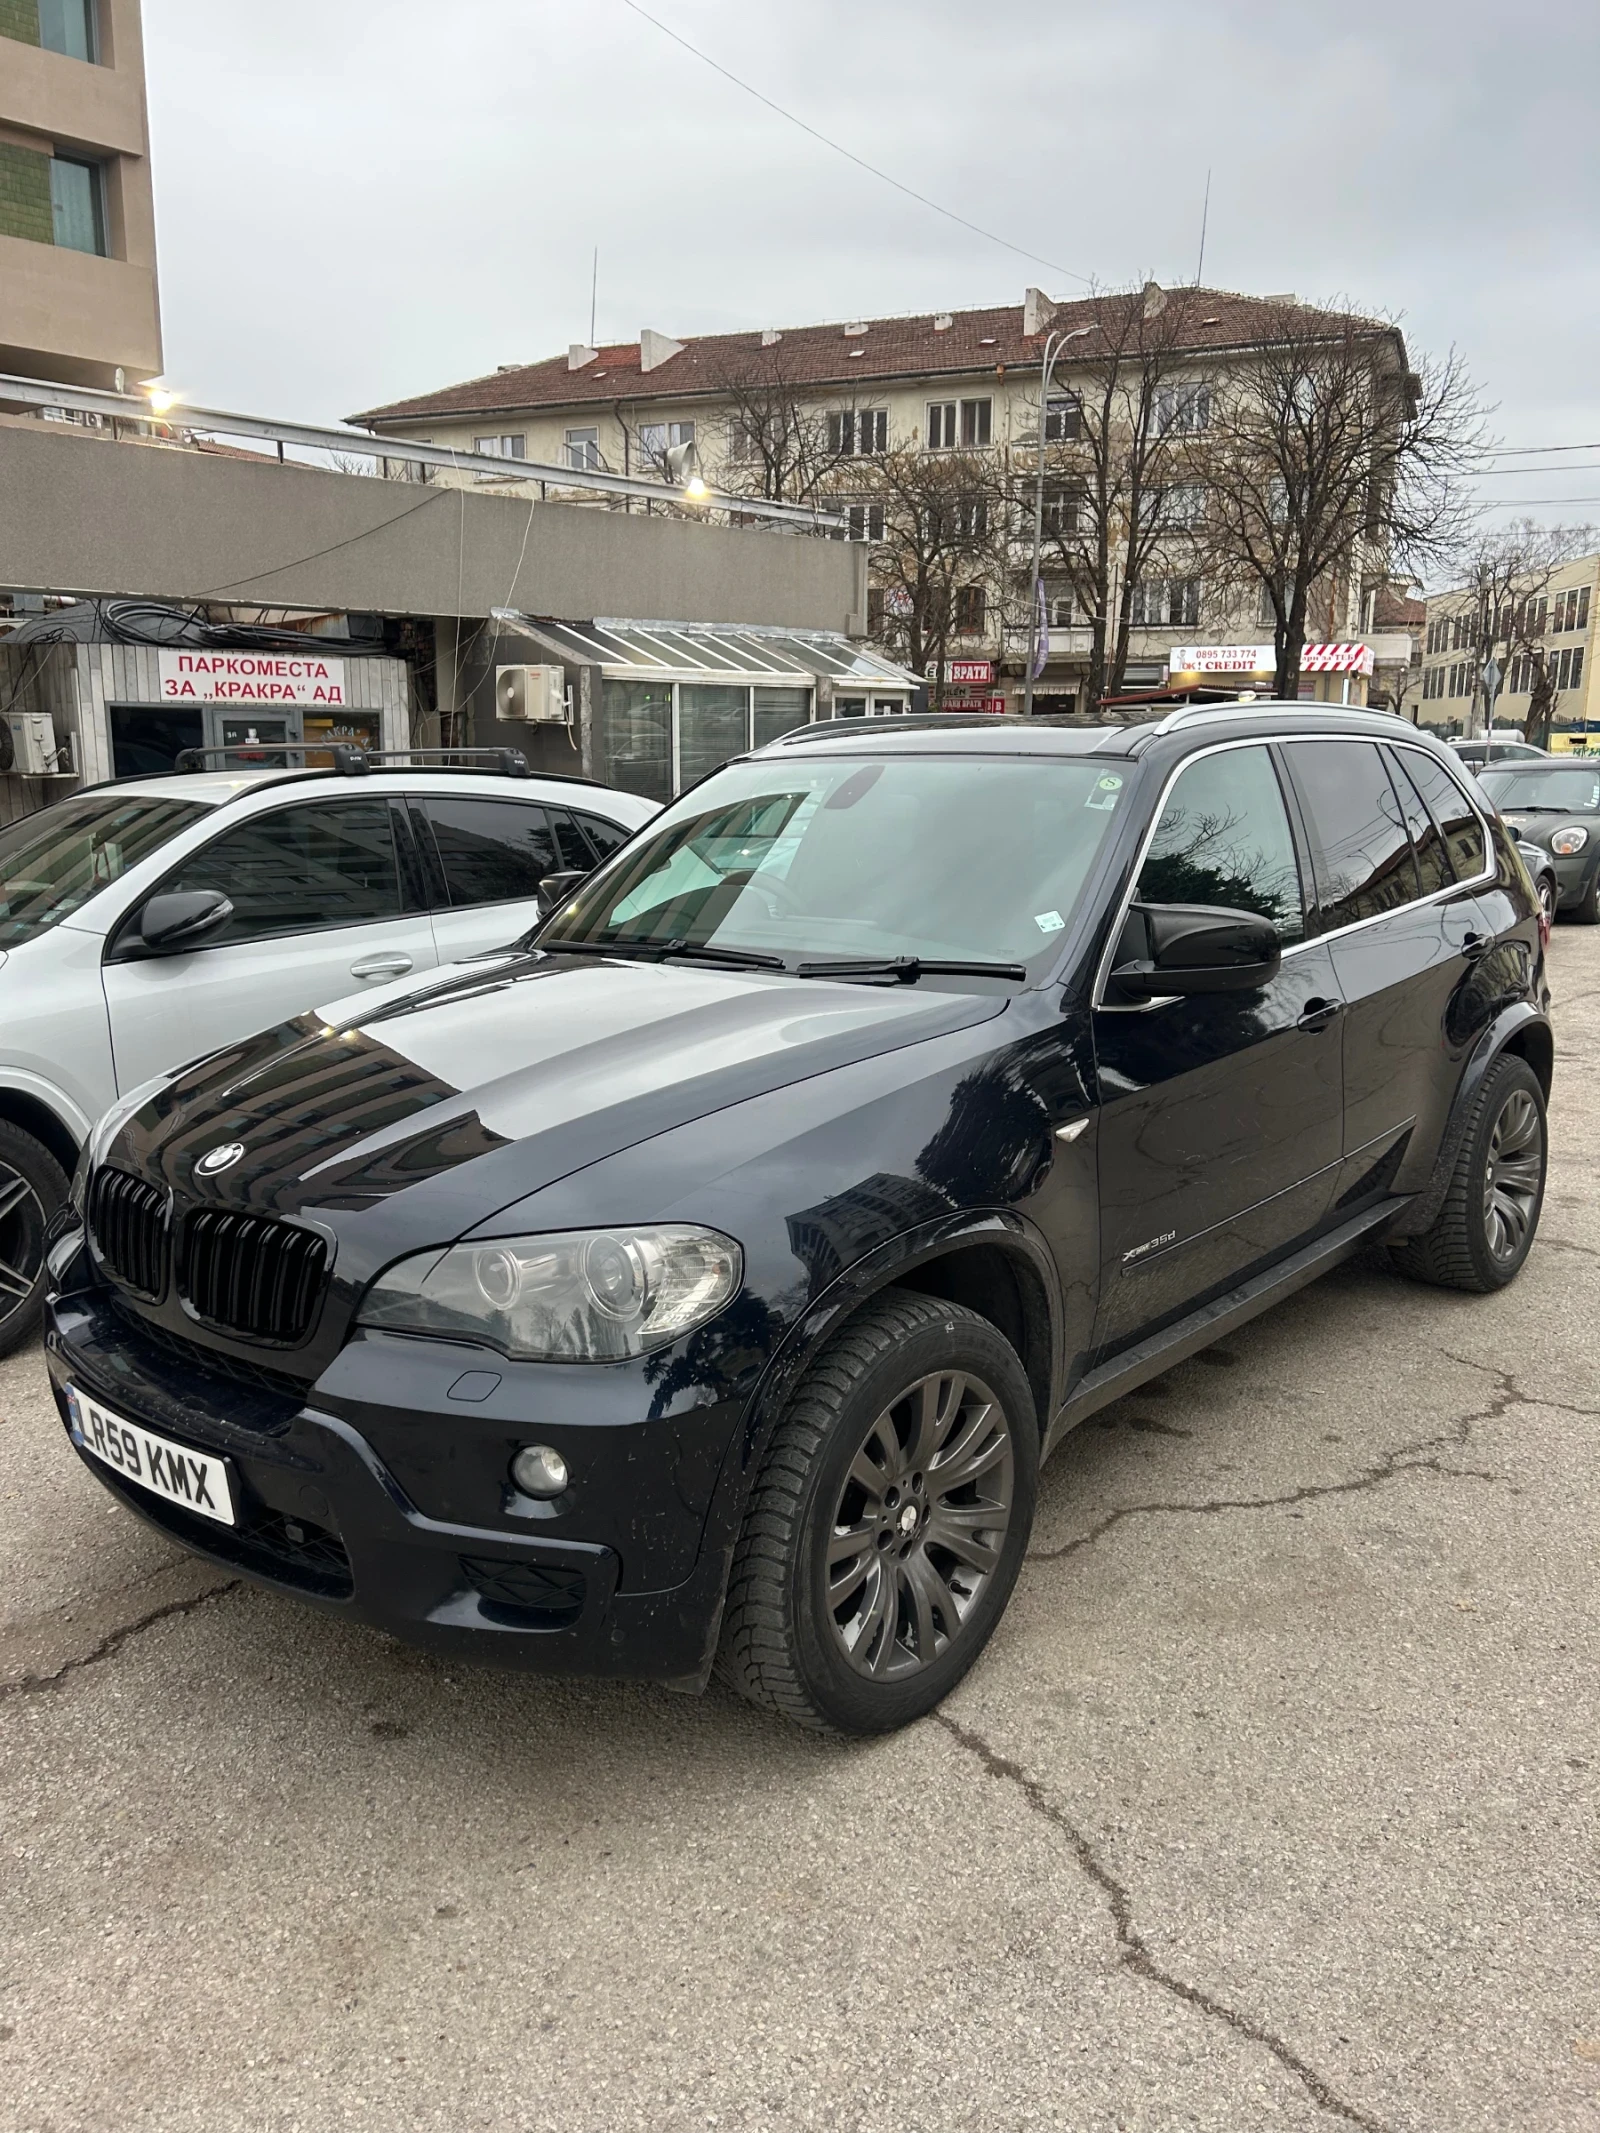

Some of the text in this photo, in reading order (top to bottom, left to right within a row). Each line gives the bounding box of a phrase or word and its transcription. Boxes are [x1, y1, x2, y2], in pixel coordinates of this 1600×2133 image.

[1196, 649, 1257, 659] 0895 733 774
[178, 655, 329, 678] ПАРКОМЕСТА
[953, 665, 988, 680] ВРАТИ
[1205, 660, 1257, 670] CREDIT
[165, 679, 196, 696] ЗА
[312, 685, 342, 704] АД
[76, 1398, 216, 1510] LR59 KMX
